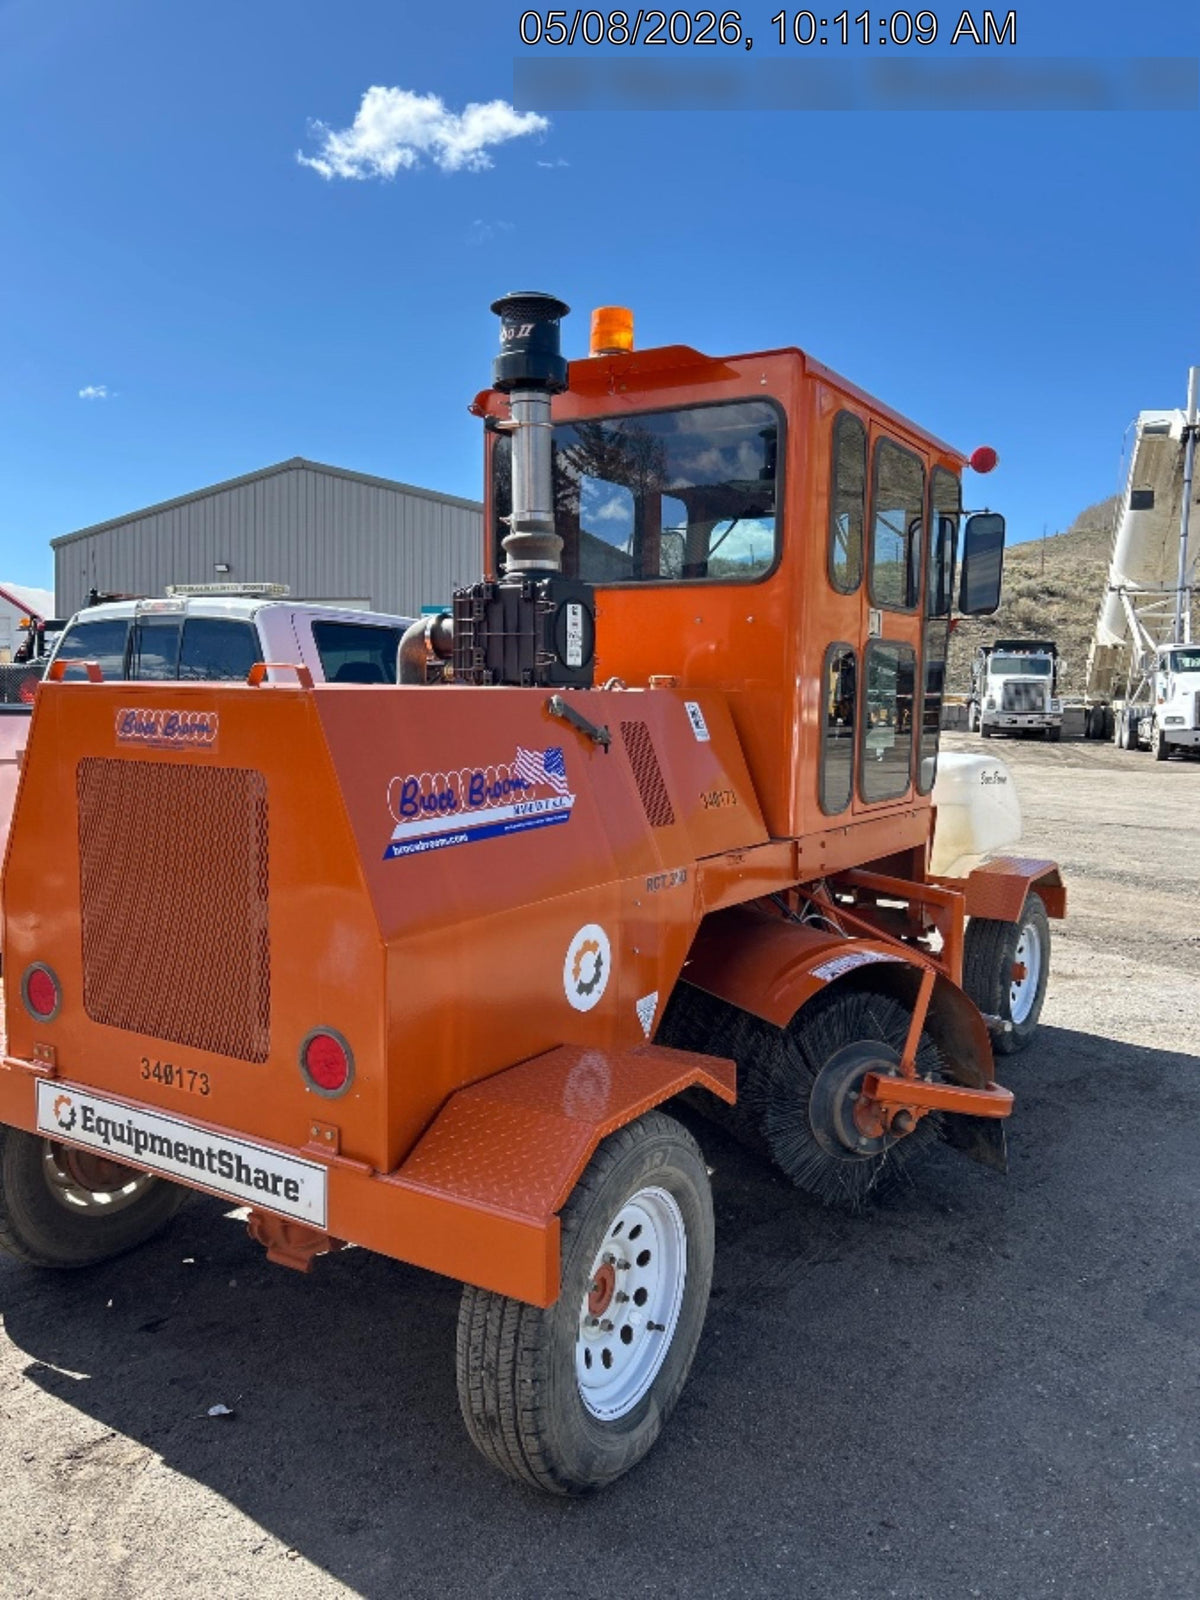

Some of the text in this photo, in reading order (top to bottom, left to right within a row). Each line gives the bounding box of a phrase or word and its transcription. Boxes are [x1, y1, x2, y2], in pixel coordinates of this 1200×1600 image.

[400, 778, 457, 817] Broce
[469, 773, 531, 807] Broom
[141, 1057, 211, 1095] 340173
[81, 1105, 300, 1202] EquipmentShare
